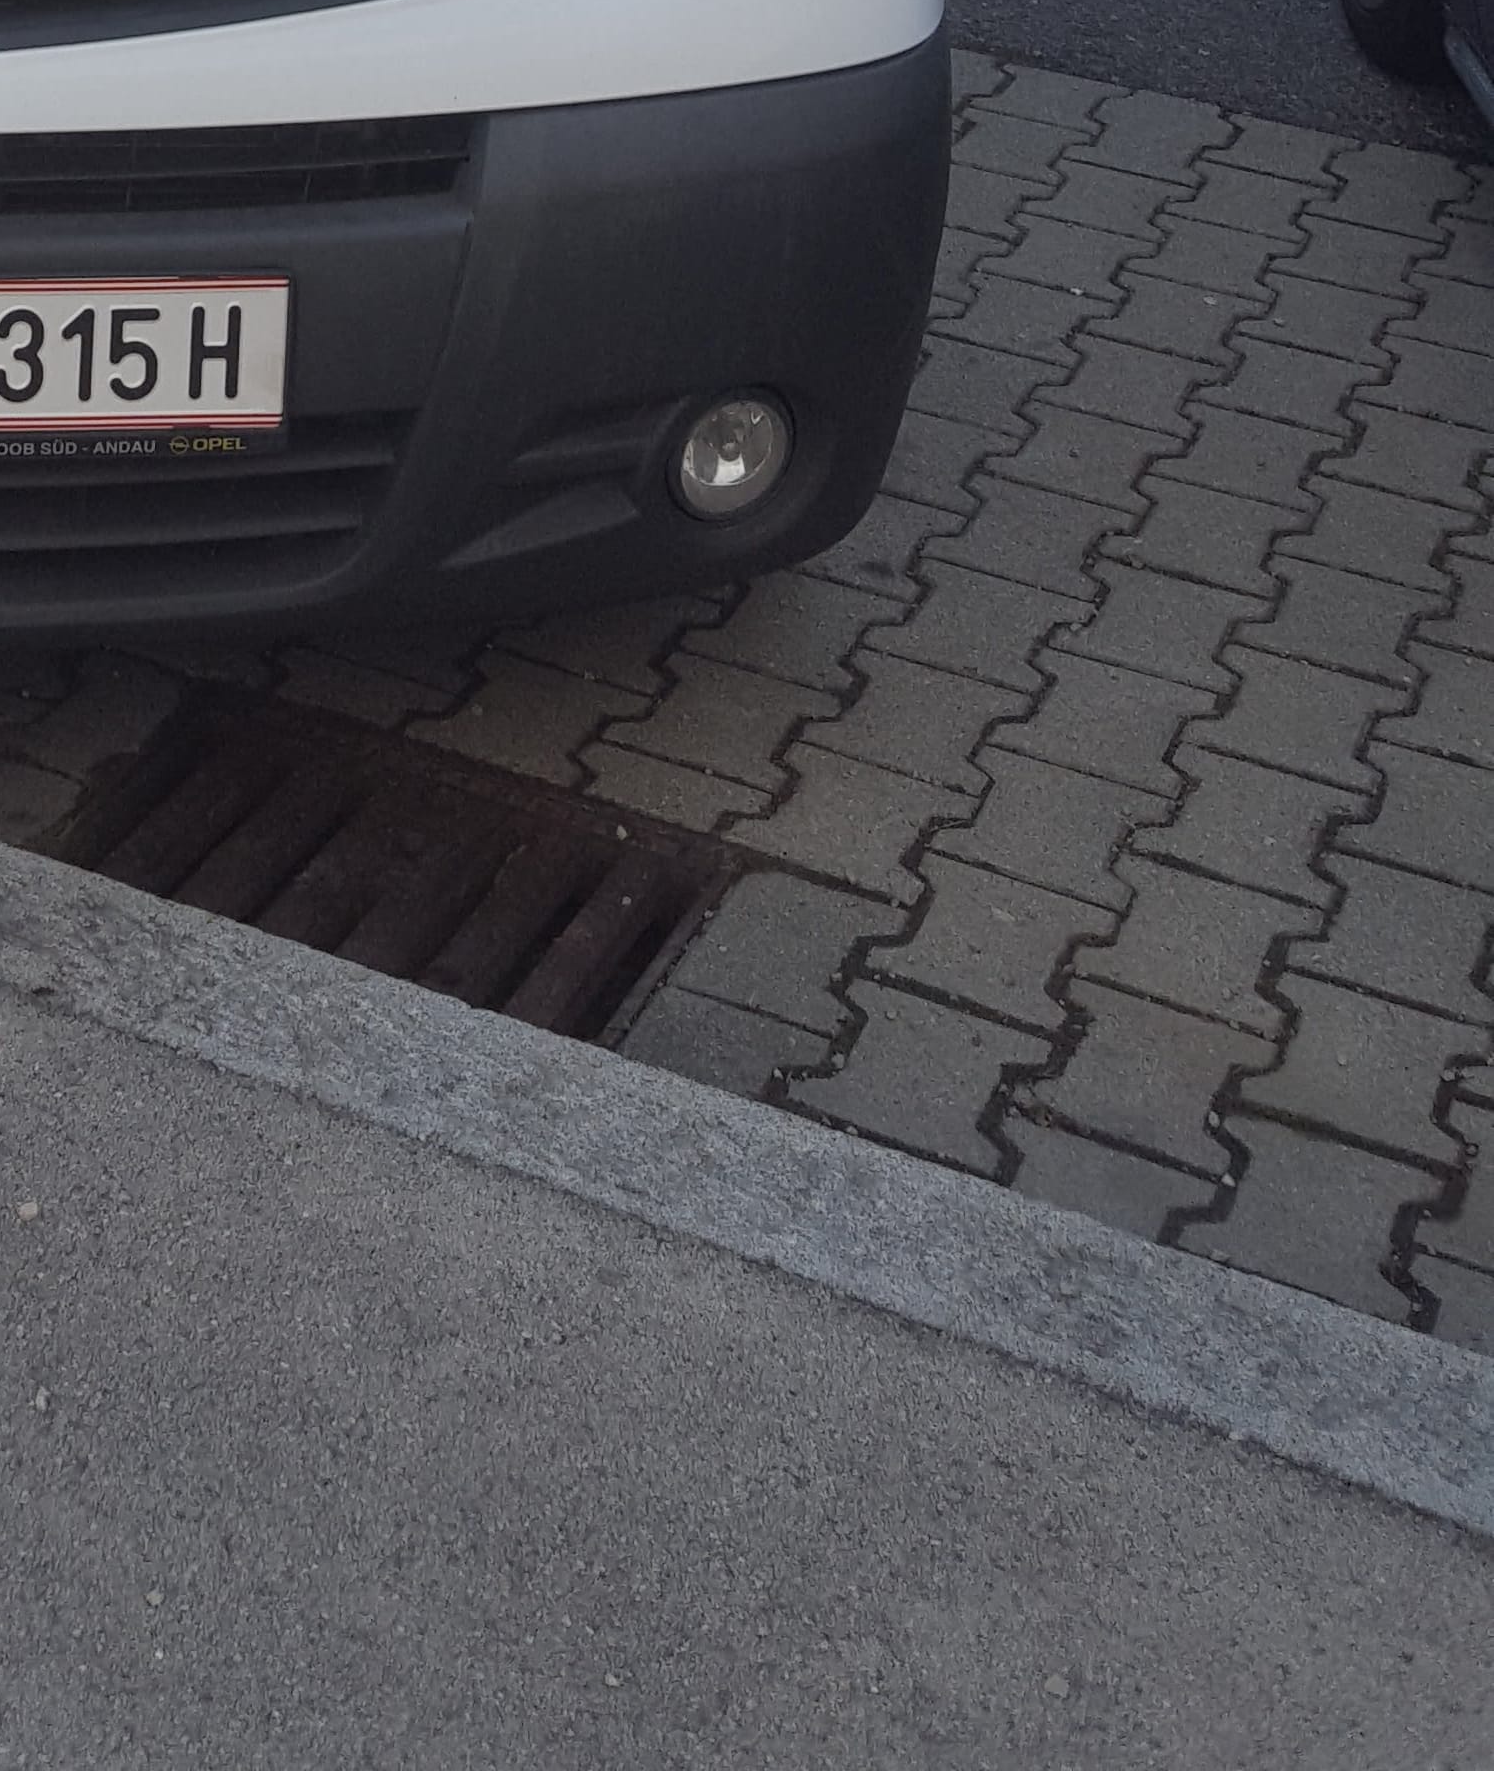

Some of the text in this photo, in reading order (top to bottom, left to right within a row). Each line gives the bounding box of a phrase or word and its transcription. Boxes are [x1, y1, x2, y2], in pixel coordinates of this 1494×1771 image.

[188, 304, 242, 399] H
[40, 439, 78, 456] SÜD
[92, 440, 157, 455] ANDAU
[192, 436, 247, 452] OPEL
